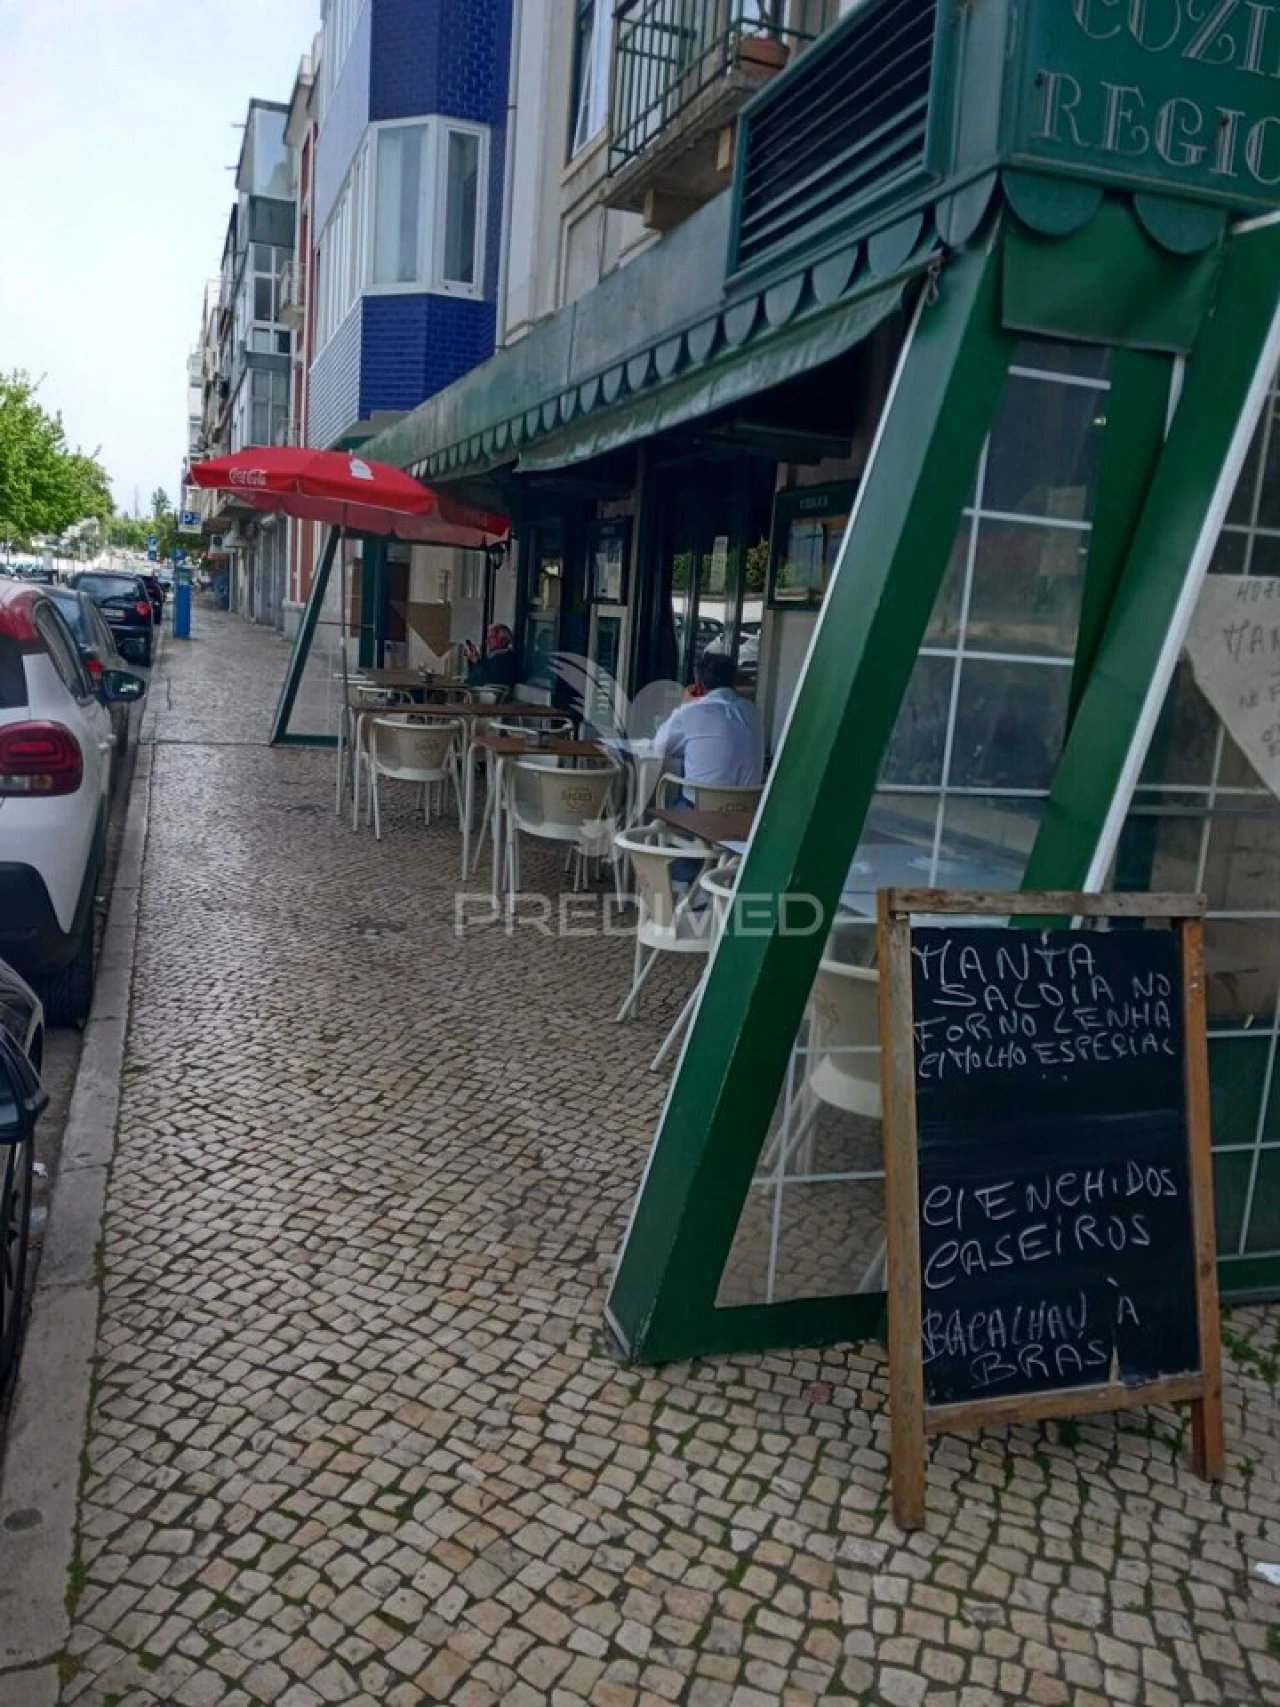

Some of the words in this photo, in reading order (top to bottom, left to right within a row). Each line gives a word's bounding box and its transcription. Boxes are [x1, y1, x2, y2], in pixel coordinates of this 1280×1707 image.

[1073, 0, 1280, 79] COZI
[911, 939, 1096, 986] MANTA
[933, 976, 1115, 1011] SALOIA
[1132, 971, 1171, 999] NO
[914, 1010, 1036, 1051] FORNO
[1054, 1001, 1171, 1034] LENHA
[924, 1214, 1150, 1289] CASEIROS
[970, 1341, 1109, 1389] BRAS
